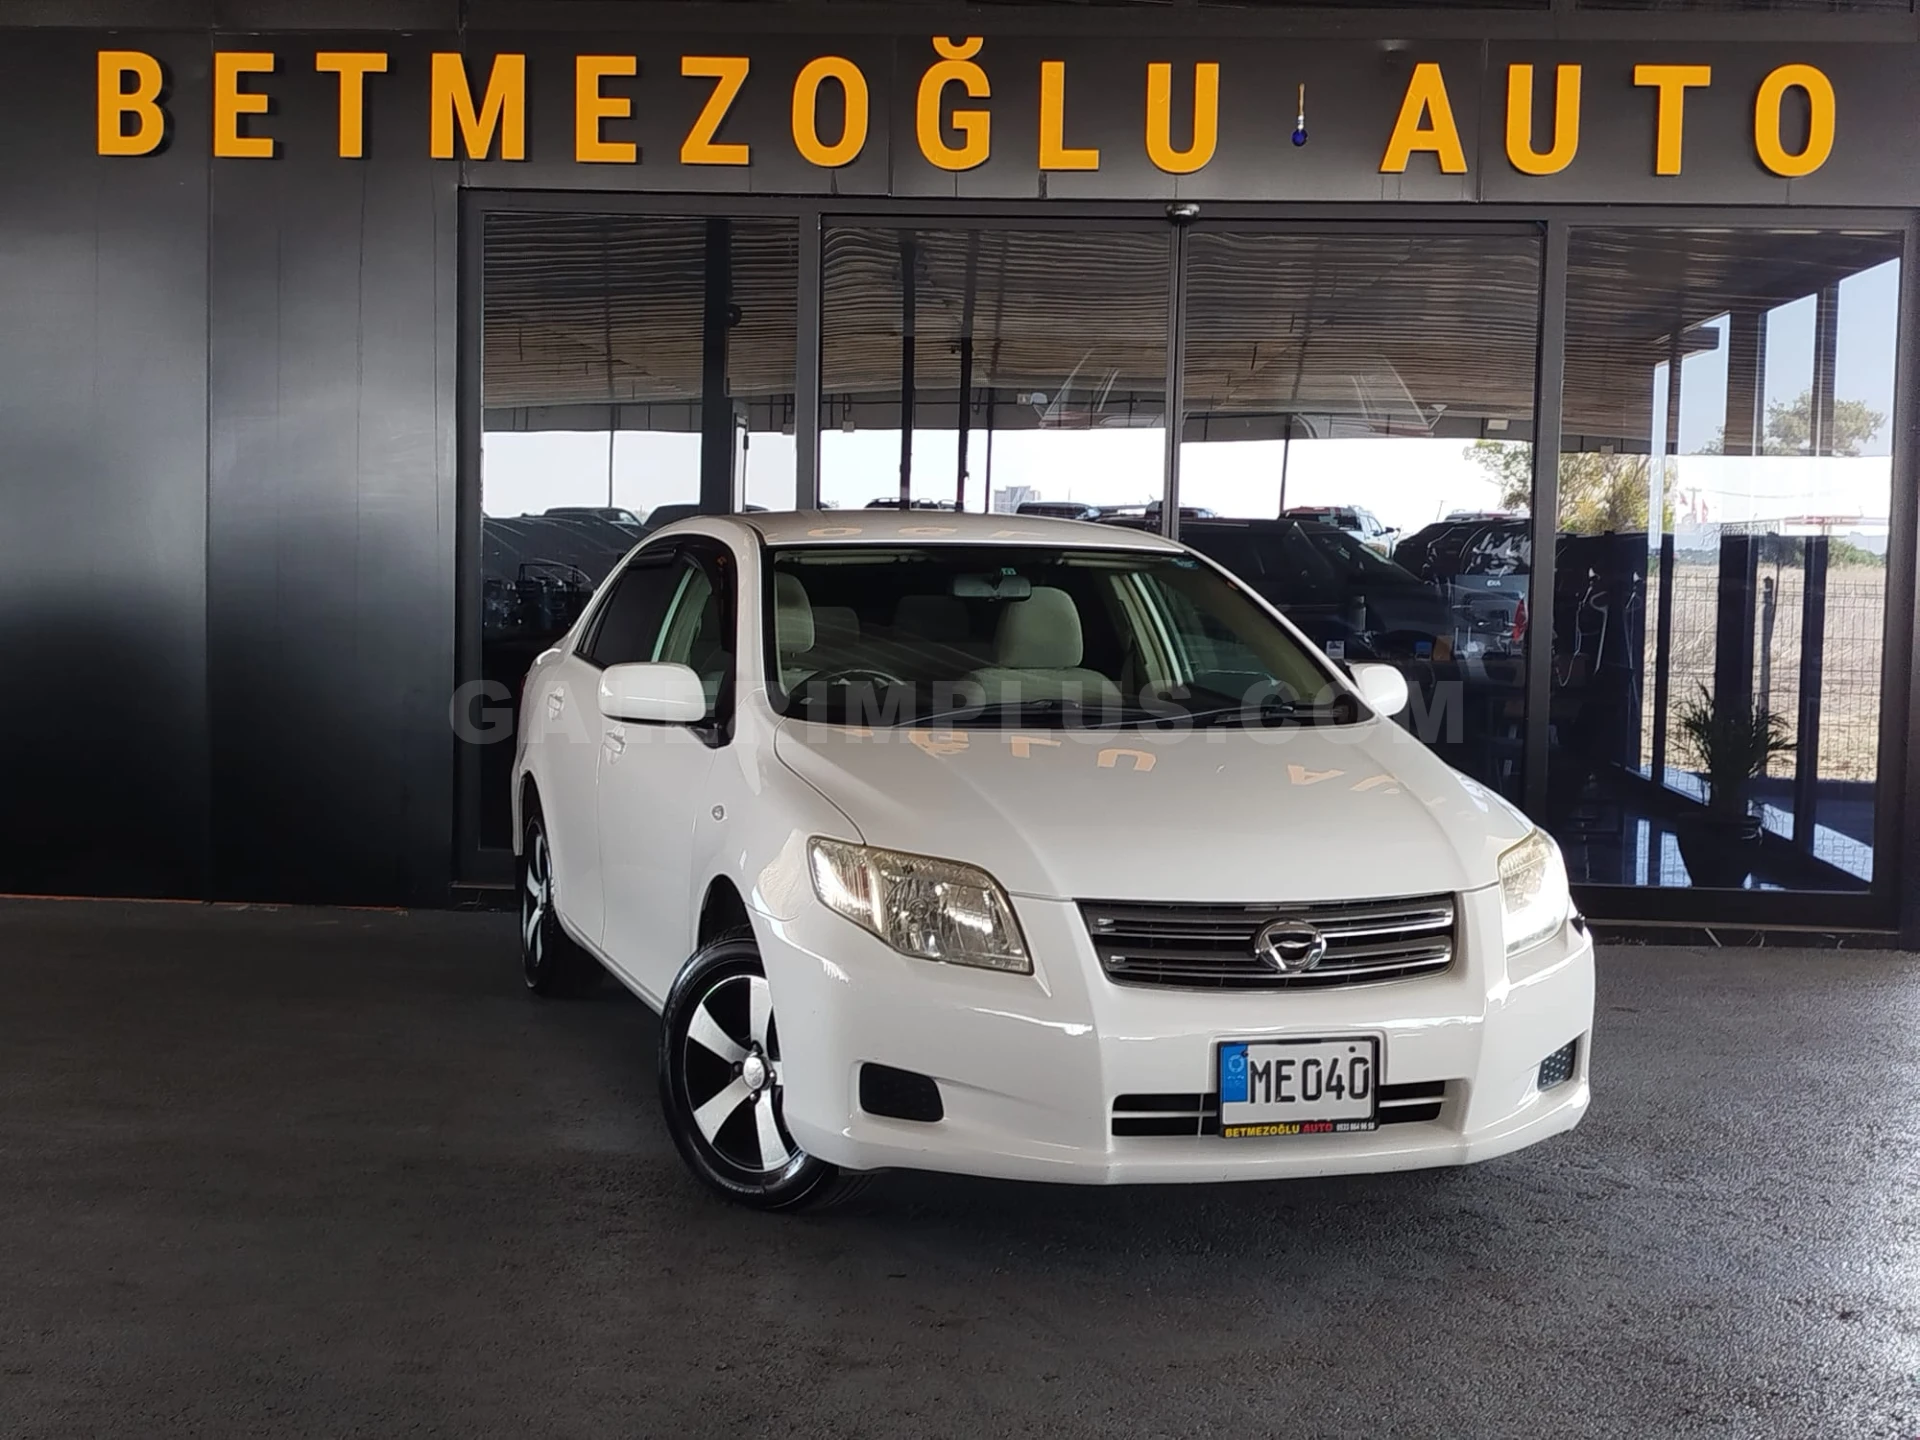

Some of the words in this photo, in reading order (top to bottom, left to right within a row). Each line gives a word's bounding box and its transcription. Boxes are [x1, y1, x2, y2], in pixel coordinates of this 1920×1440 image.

[97, 36, 1220, 173] BETMEZOĞLU
[1380, 63, 1836, 177] AUTO
[1225, 1124, 1300, 1138] BETMEZOĞLU
[1303, 1123, 1333, 1133] AUTO
